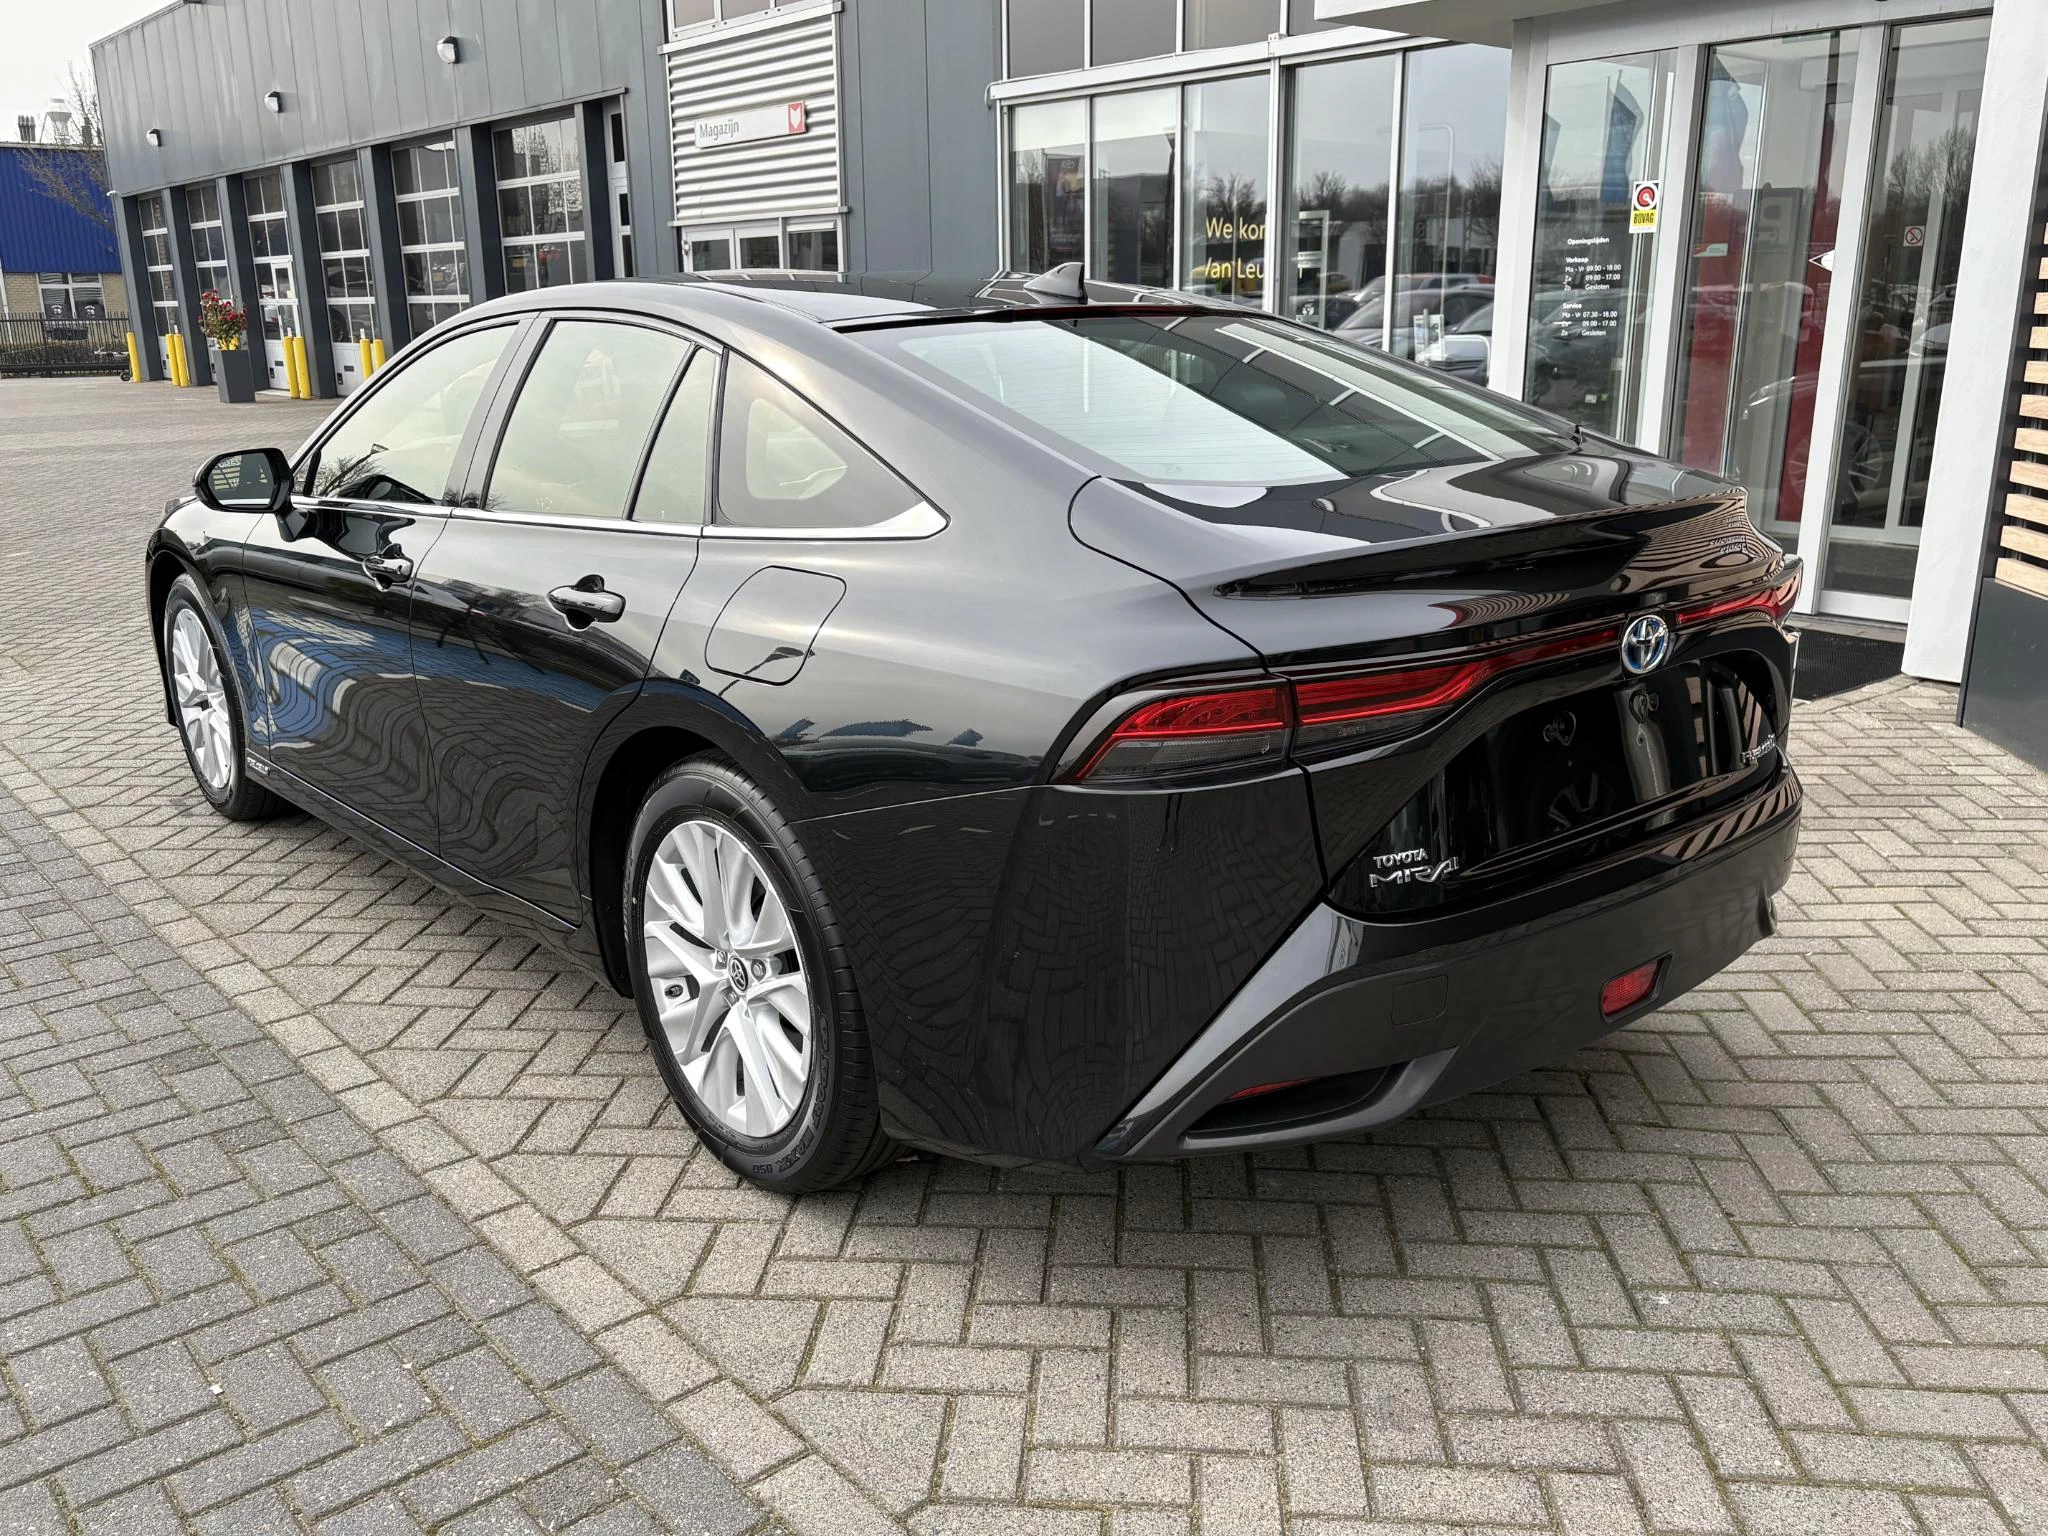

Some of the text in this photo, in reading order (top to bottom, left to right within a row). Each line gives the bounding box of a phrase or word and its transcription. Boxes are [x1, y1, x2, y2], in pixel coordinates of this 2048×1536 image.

[699, 119, 740, 141] Magazijn
[1633, 212, 1655, 224] BOVAG
[1205, 216, 1266, 240] Weko
[1567, 237, 1610, 245] Openingstijden
[1581, 329, 1607, 337] Gesloten
[1373, 848, 1428, 869] TOYOTA
